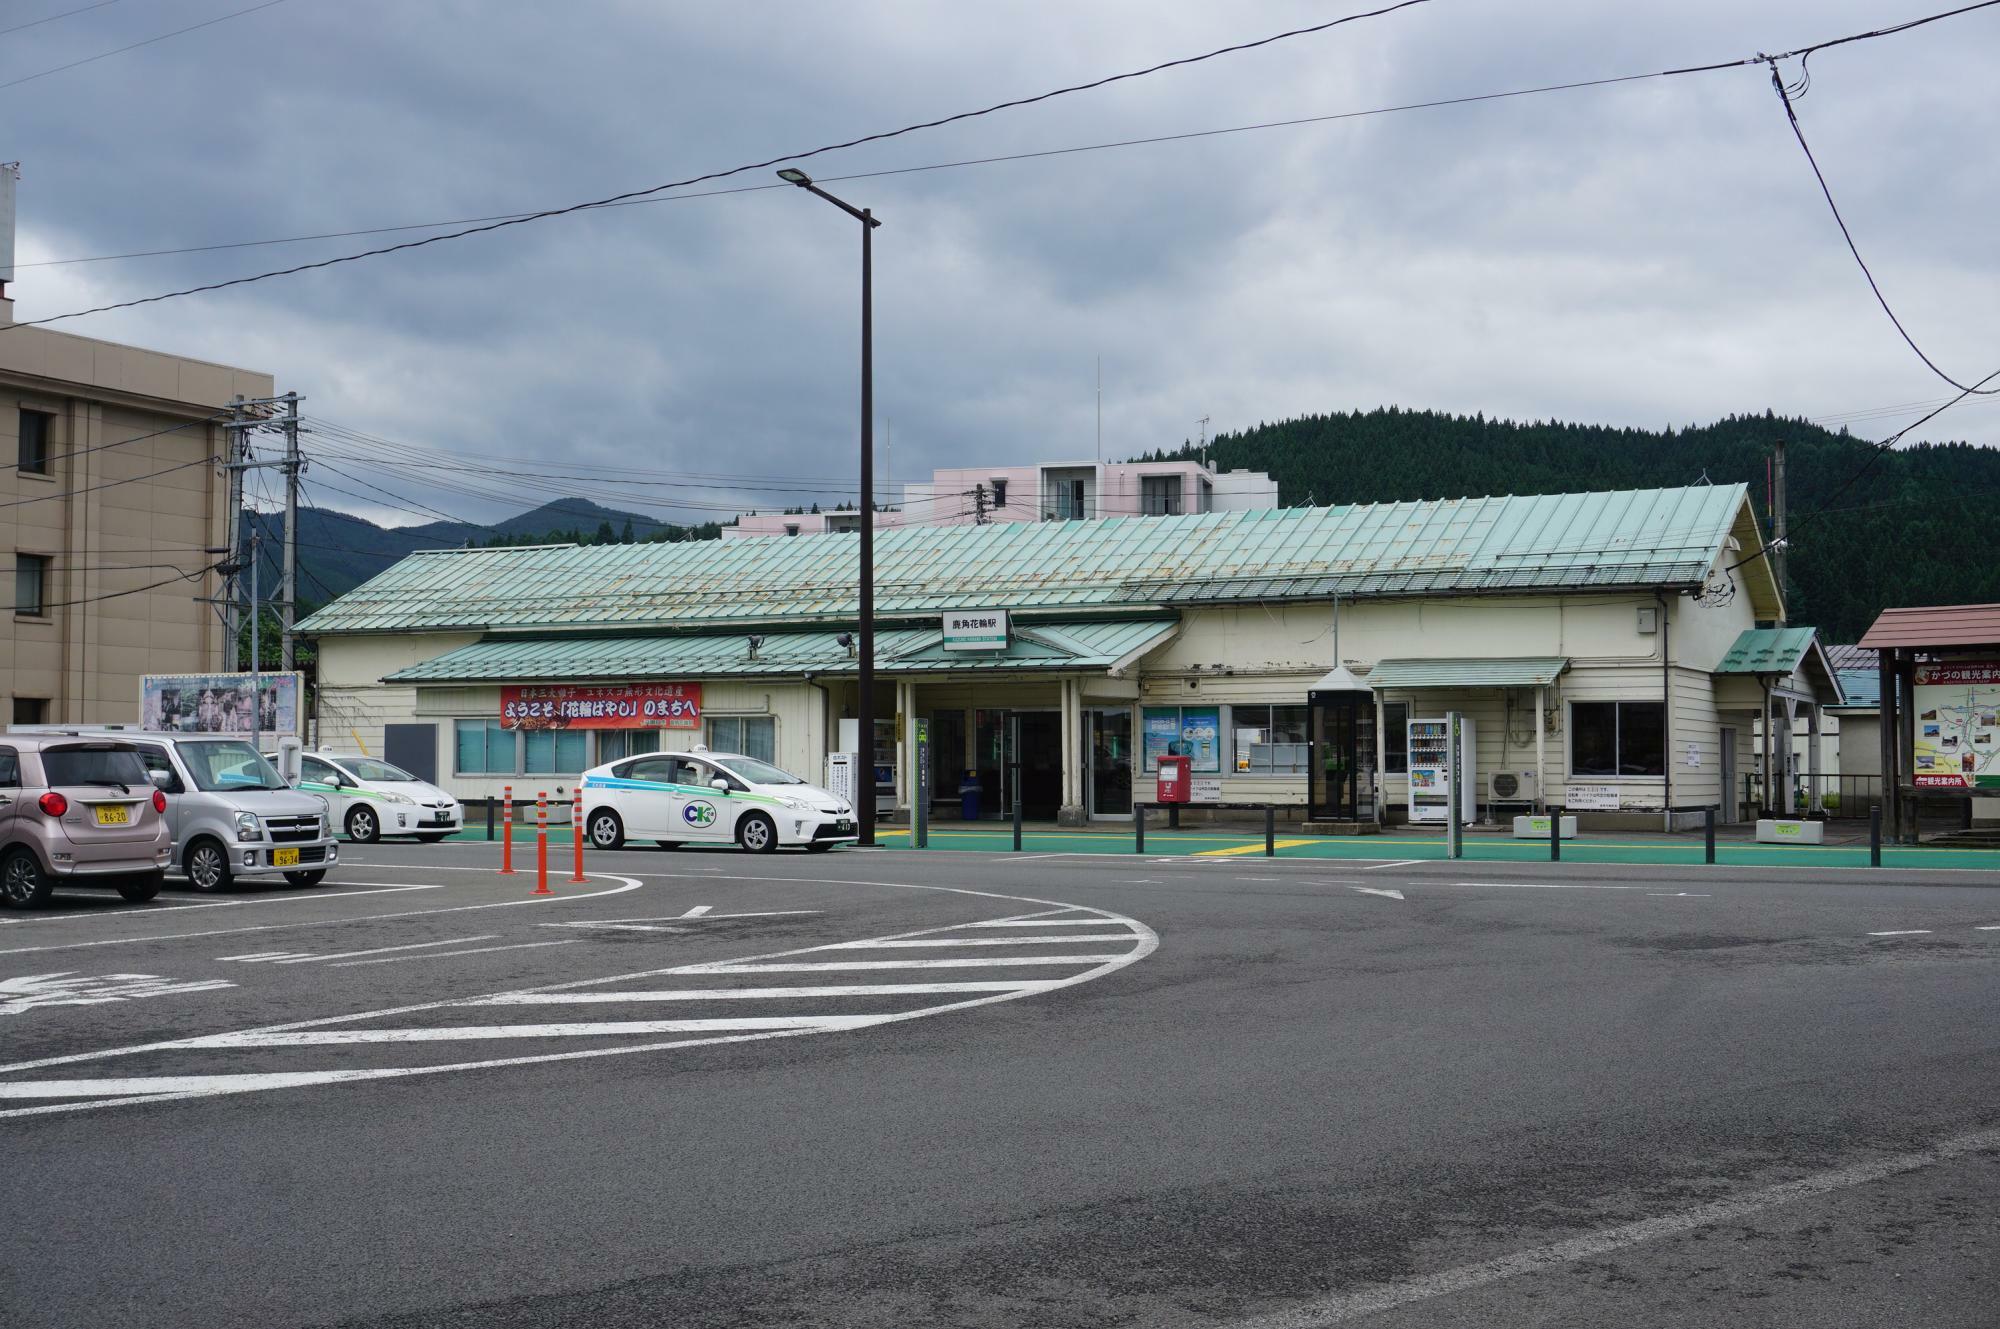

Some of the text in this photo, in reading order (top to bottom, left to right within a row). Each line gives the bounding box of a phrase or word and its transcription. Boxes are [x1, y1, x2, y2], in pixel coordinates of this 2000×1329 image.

[952, 618, 997, 630] 鹿角花輪駅
[586, 685, 684, 698] ユネスコ無形文化遺産
[1927, 776, 1962, 786] 観光案内所
[104, 812, 127, 822] 86-20
[684, 805, 711, 823] CK
[279, 855, 298, 865] 96-34
